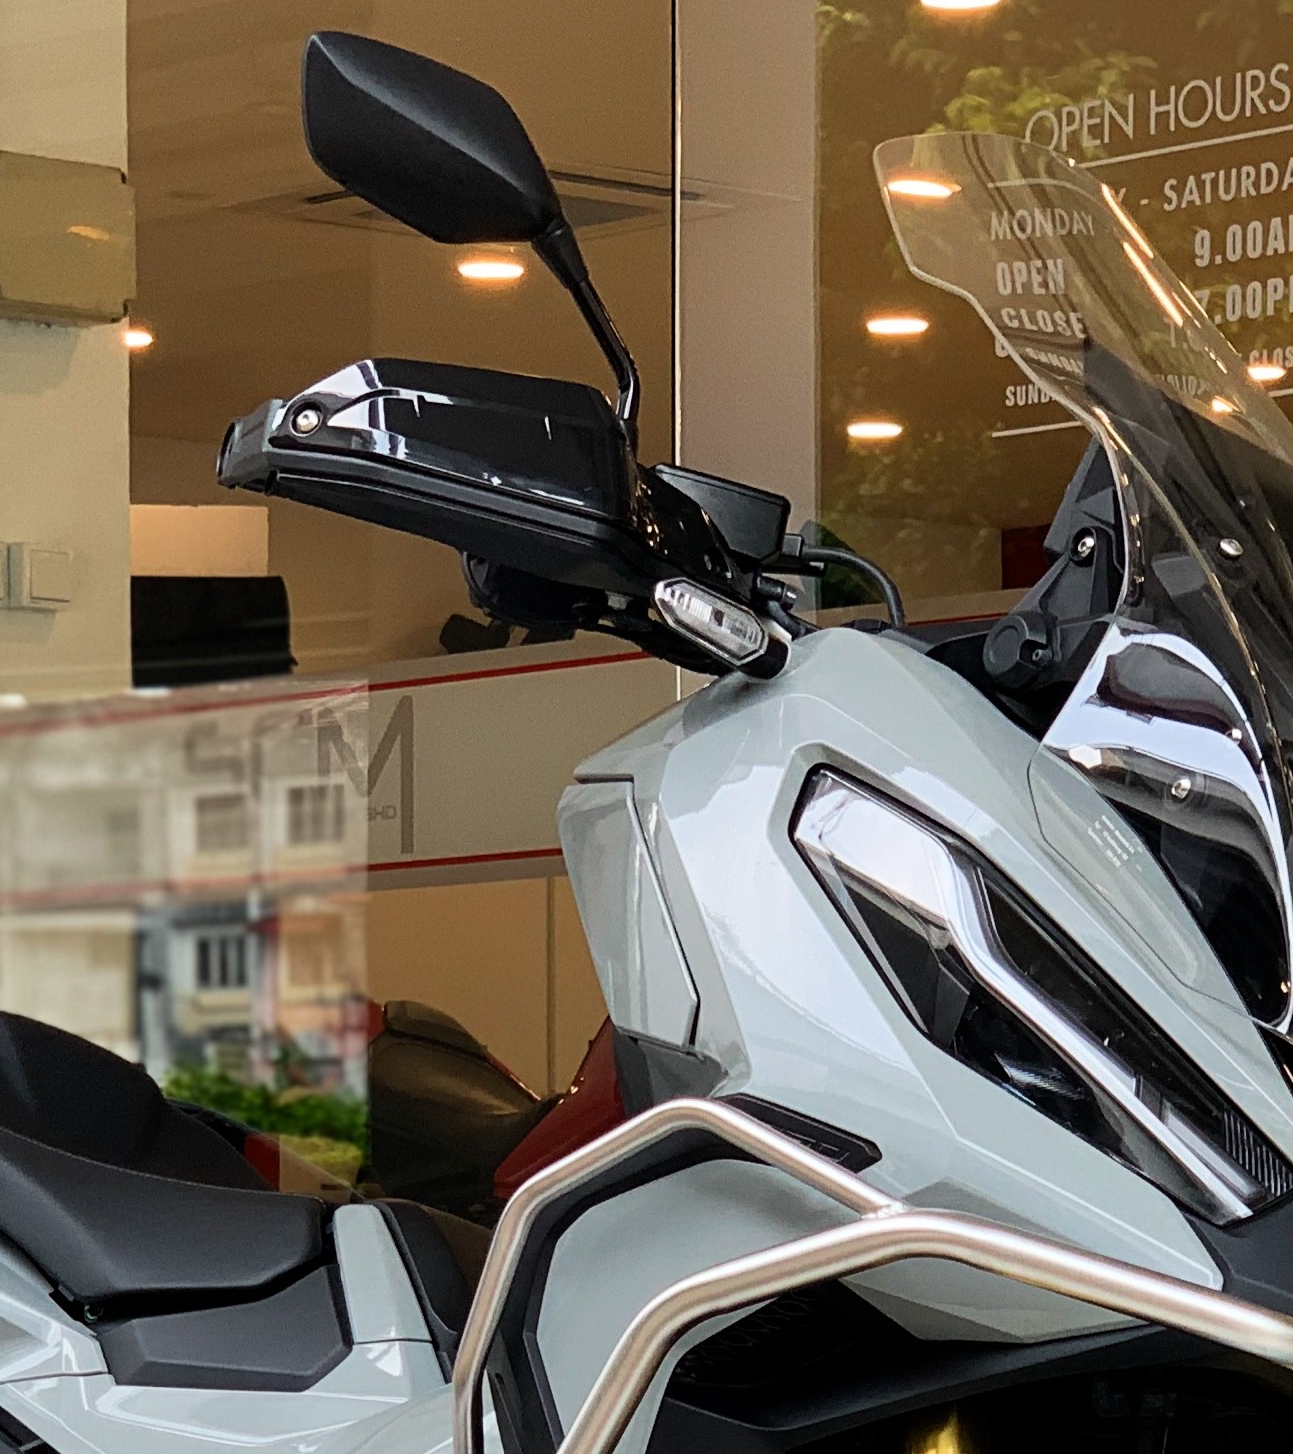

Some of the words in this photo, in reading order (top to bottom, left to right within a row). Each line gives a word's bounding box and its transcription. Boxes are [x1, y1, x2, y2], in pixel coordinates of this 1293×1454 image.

[1025, 93, 1135, 152] OPEN
[1149, 62, 1292, 136] HOURS
[990, 206, 1096, 242] MONDAY
[996, 258, 1066, 296] OPEN
[1000, 307, 1087, 339] CLOSE
